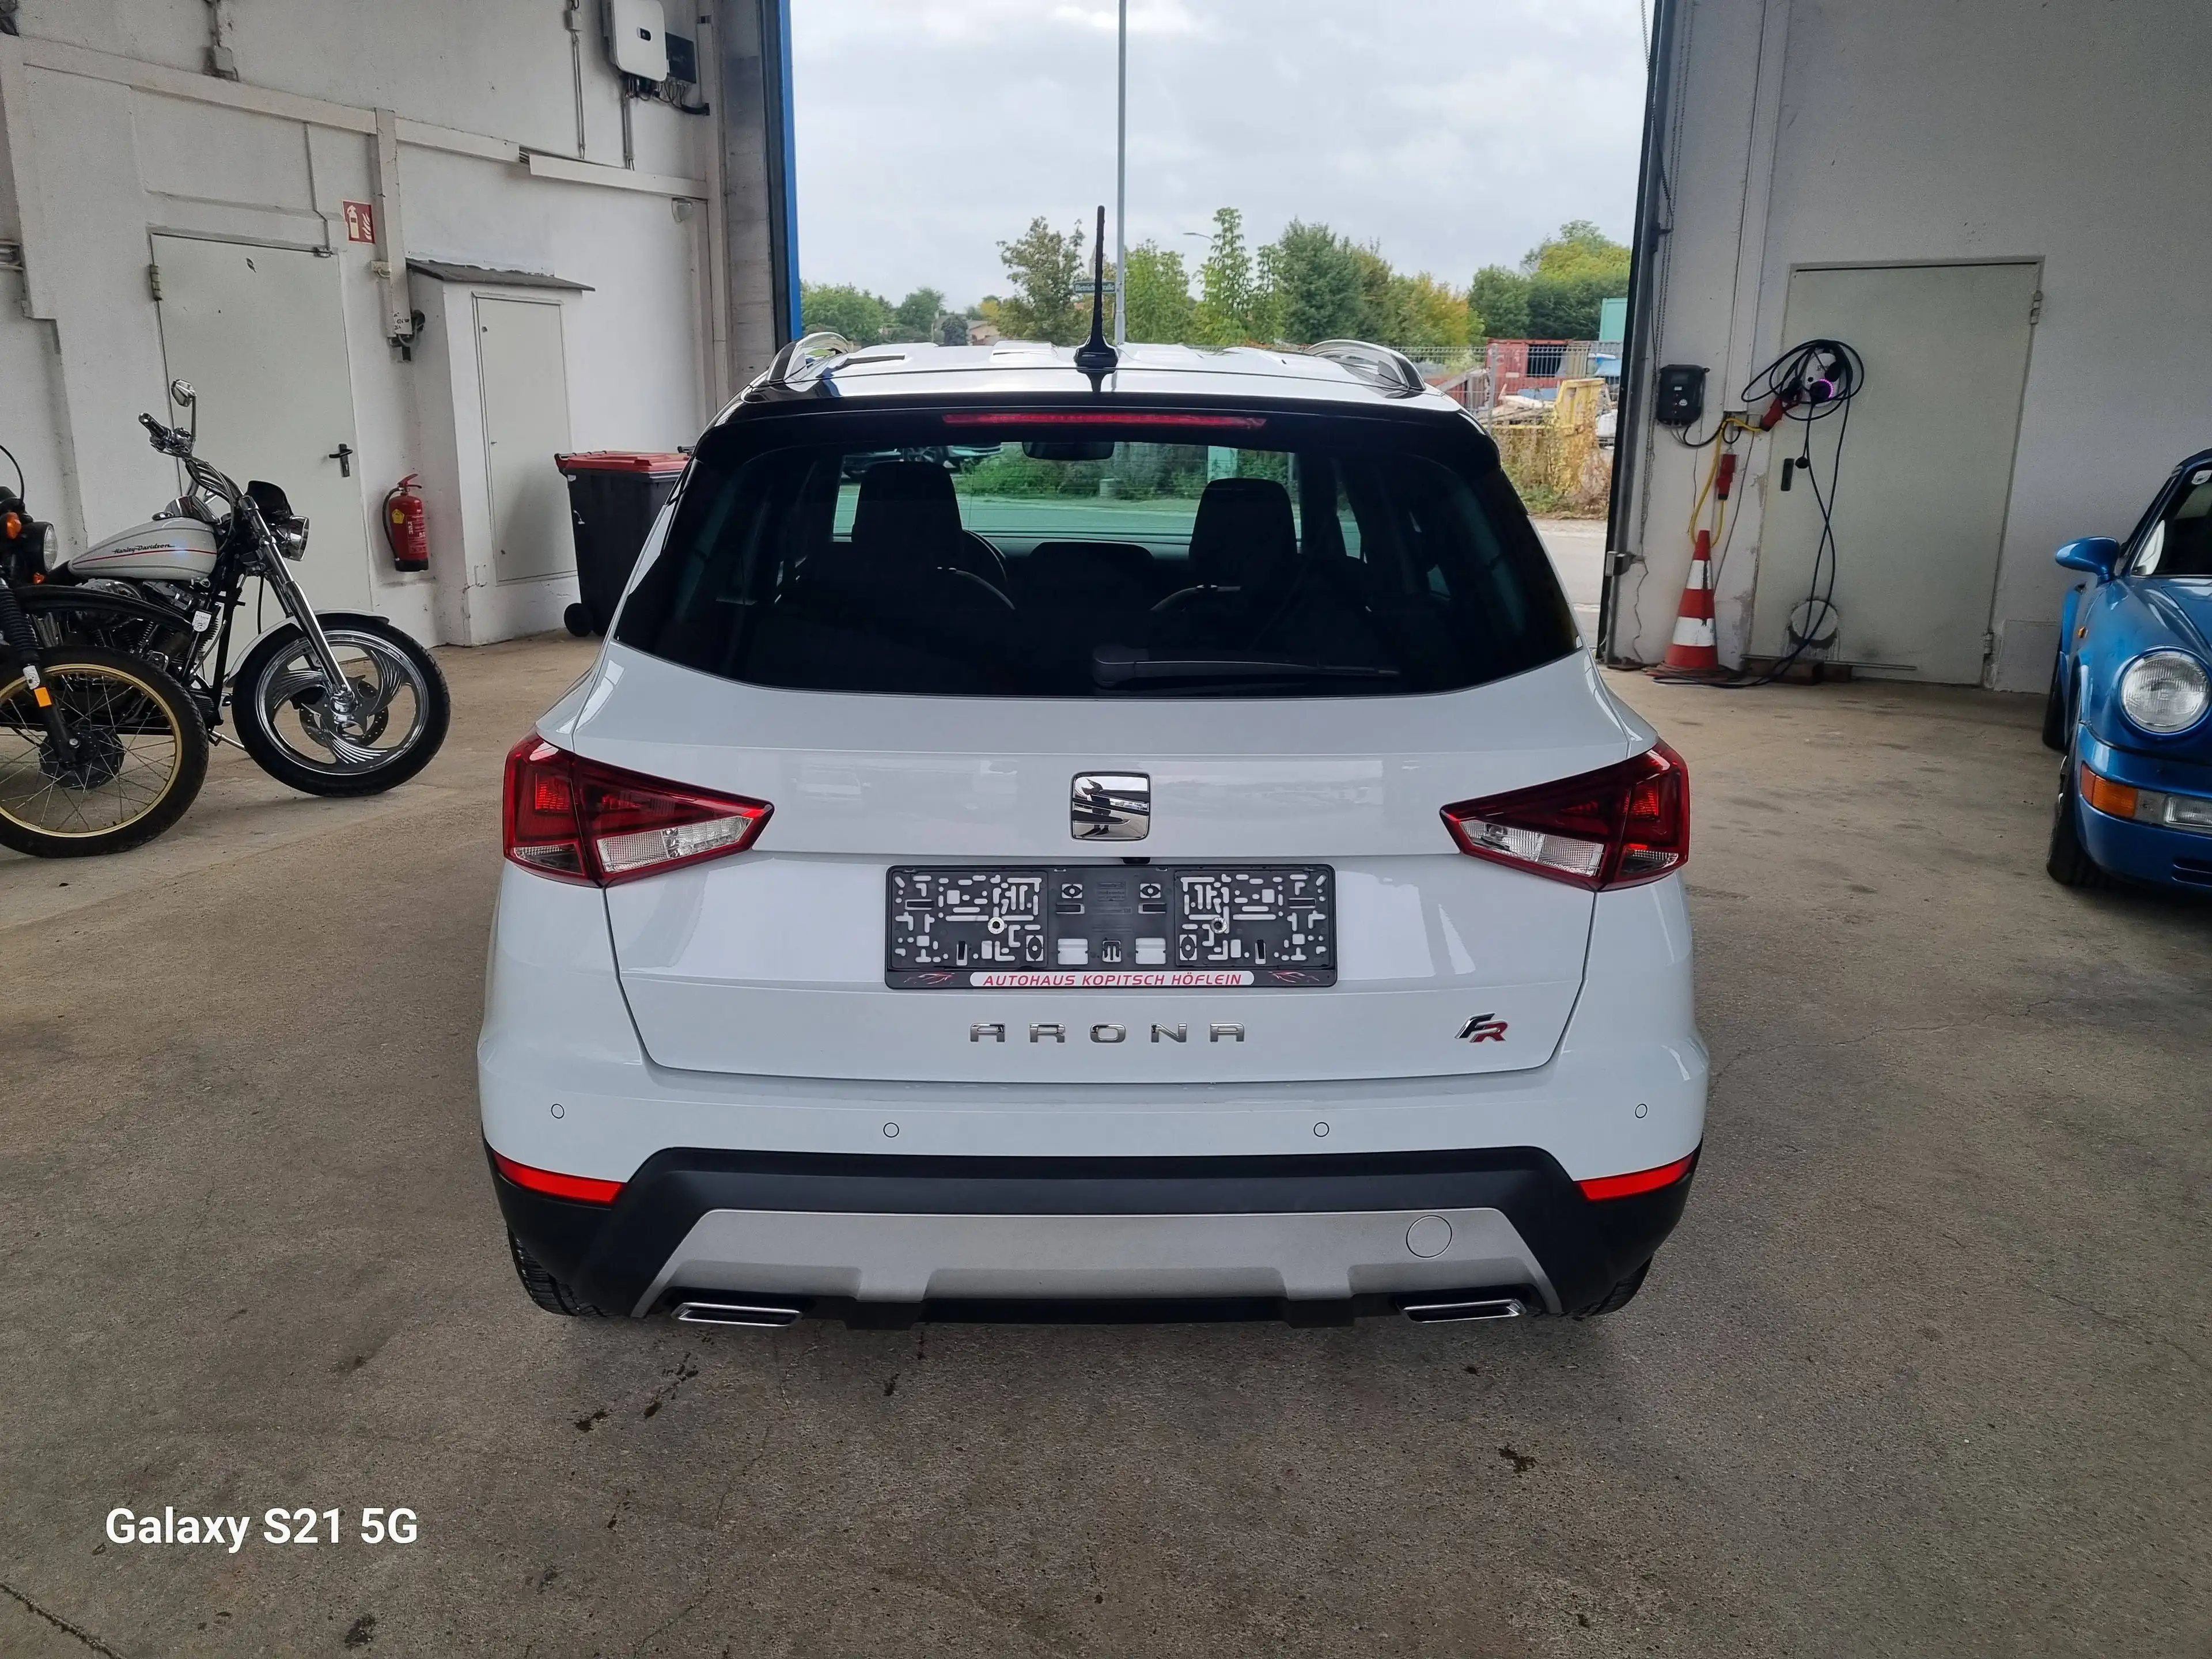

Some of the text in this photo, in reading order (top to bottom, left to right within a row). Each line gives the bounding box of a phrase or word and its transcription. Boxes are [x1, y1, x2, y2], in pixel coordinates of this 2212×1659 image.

[112, 543, 175, 554] Harley-Davidson
[983, 972, 1242, 986] AUTOHAUS KOPITSCH HÖFLEIN
[970, 1022, 1245, 1043] ARONA
[1454, 1012, 1509, 1043] FR
